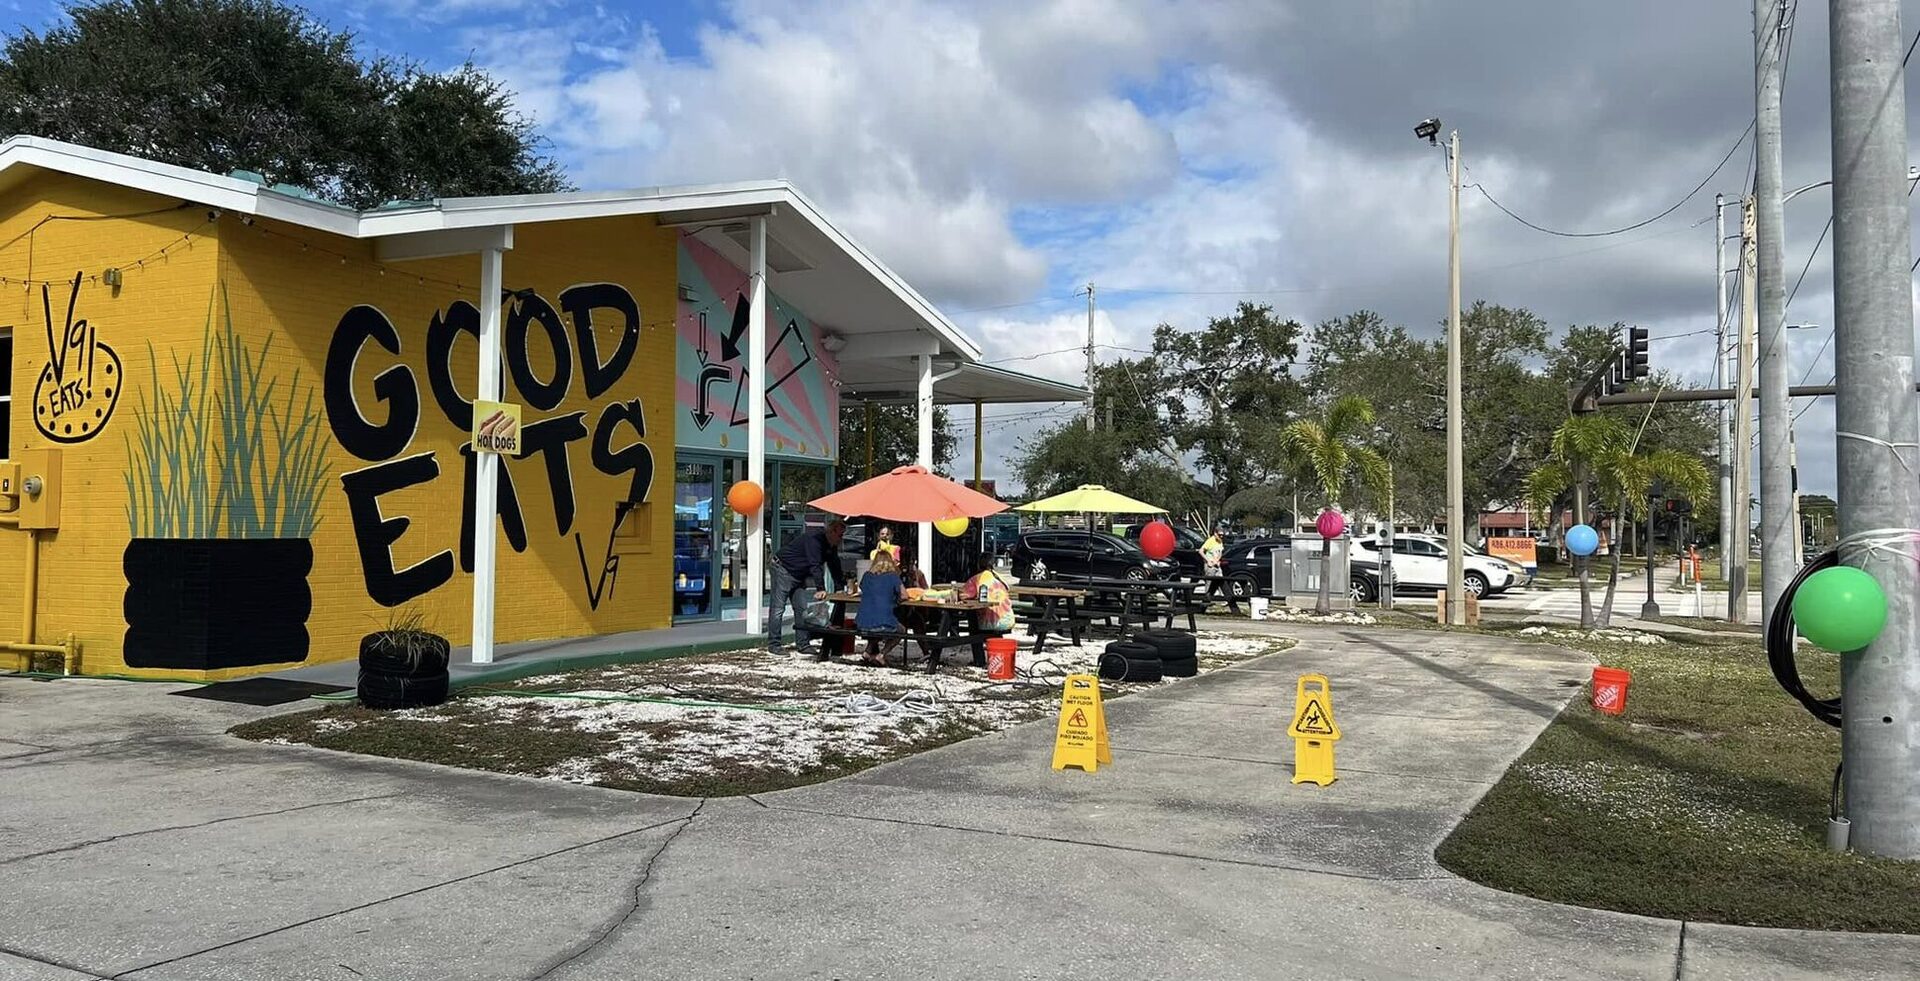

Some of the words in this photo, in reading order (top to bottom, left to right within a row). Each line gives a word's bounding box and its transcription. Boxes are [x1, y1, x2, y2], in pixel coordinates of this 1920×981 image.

[324, 282, 641, 462] GOOD
[49, 377, 84, 418] EATS
[477, 434, 493, 448] HOT
[495, 436, 516, 450] DOGS
